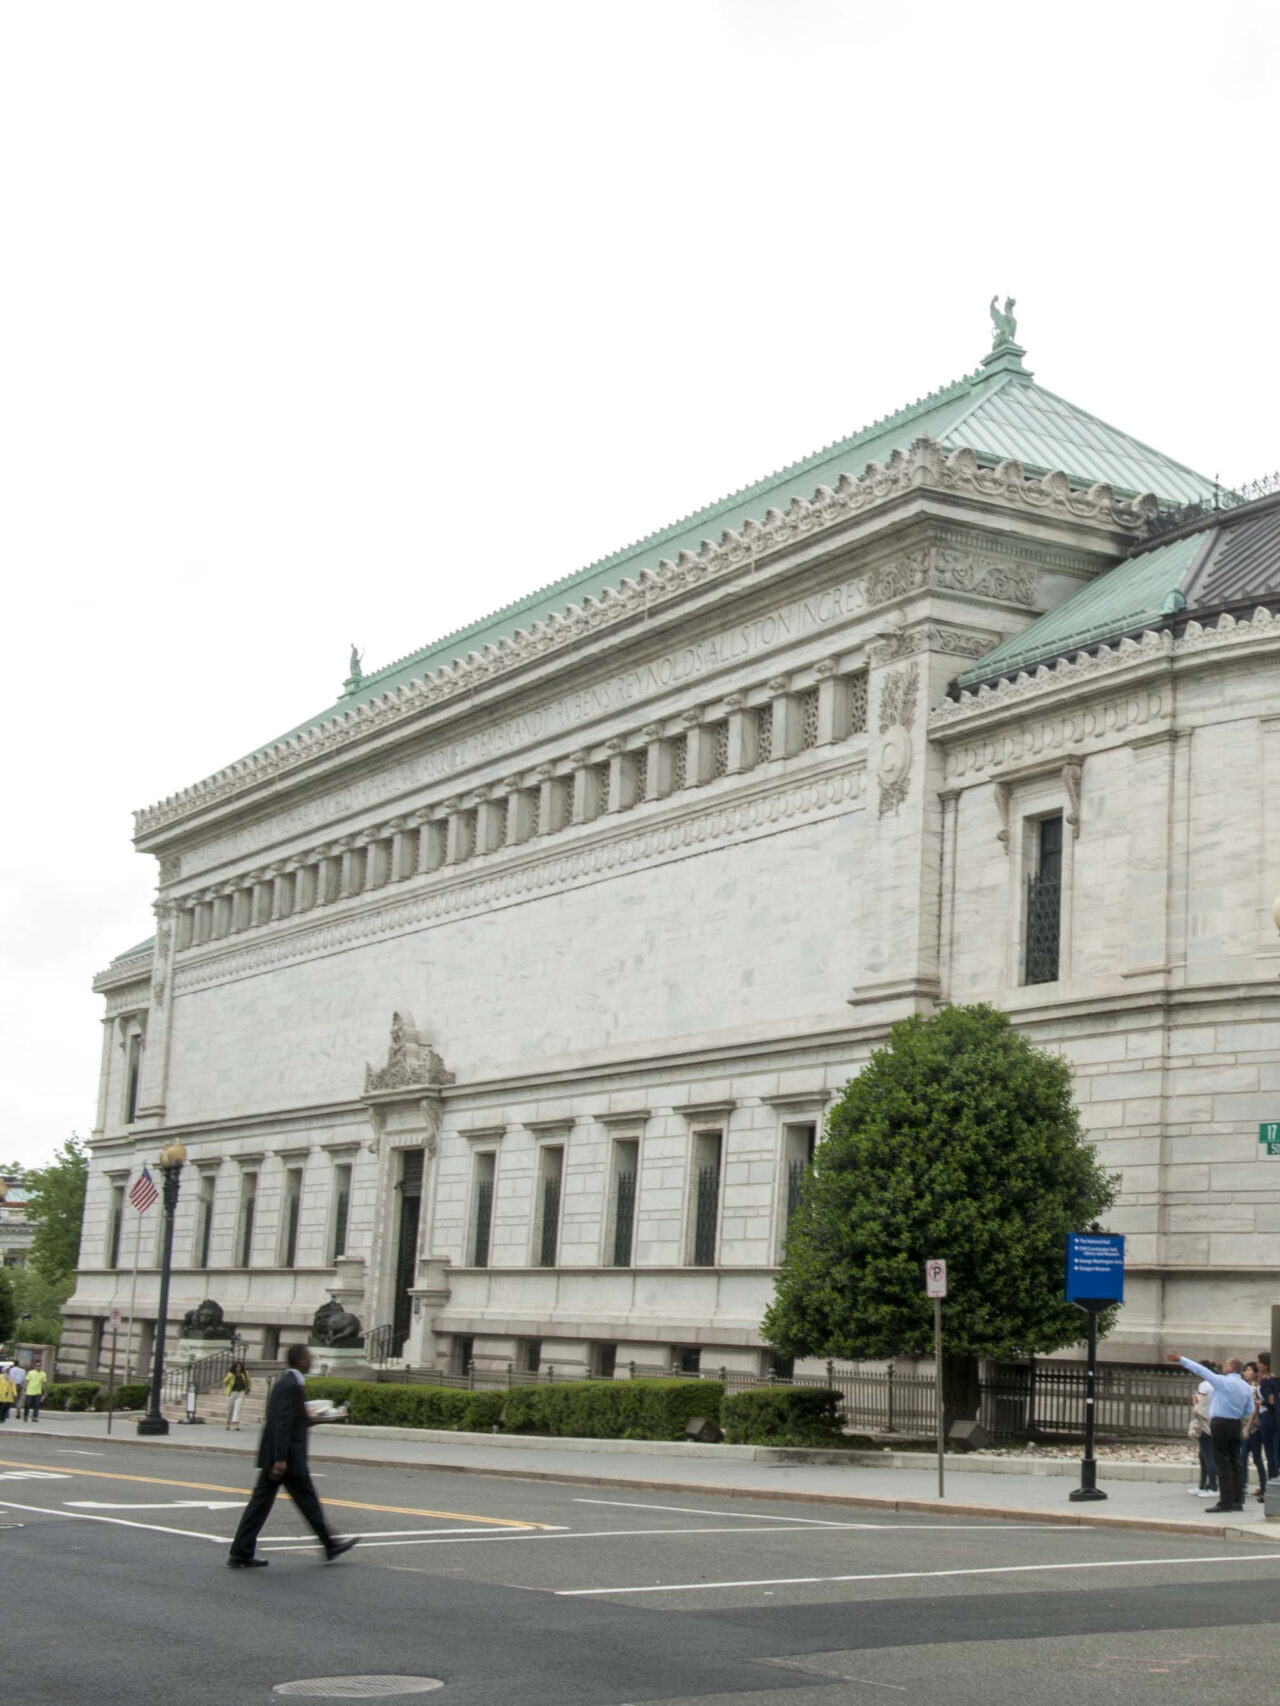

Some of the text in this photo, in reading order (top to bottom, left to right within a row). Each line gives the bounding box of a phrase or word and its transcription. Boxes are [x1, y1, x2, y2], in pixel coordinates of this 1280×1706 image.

[616, 645, 704, 702] REYNOLDS
[706, 607, 793, 665] ALLSTON
[796, 577, 867, 633] INGRES
[1267, 1124, 1278, 1140] 17
